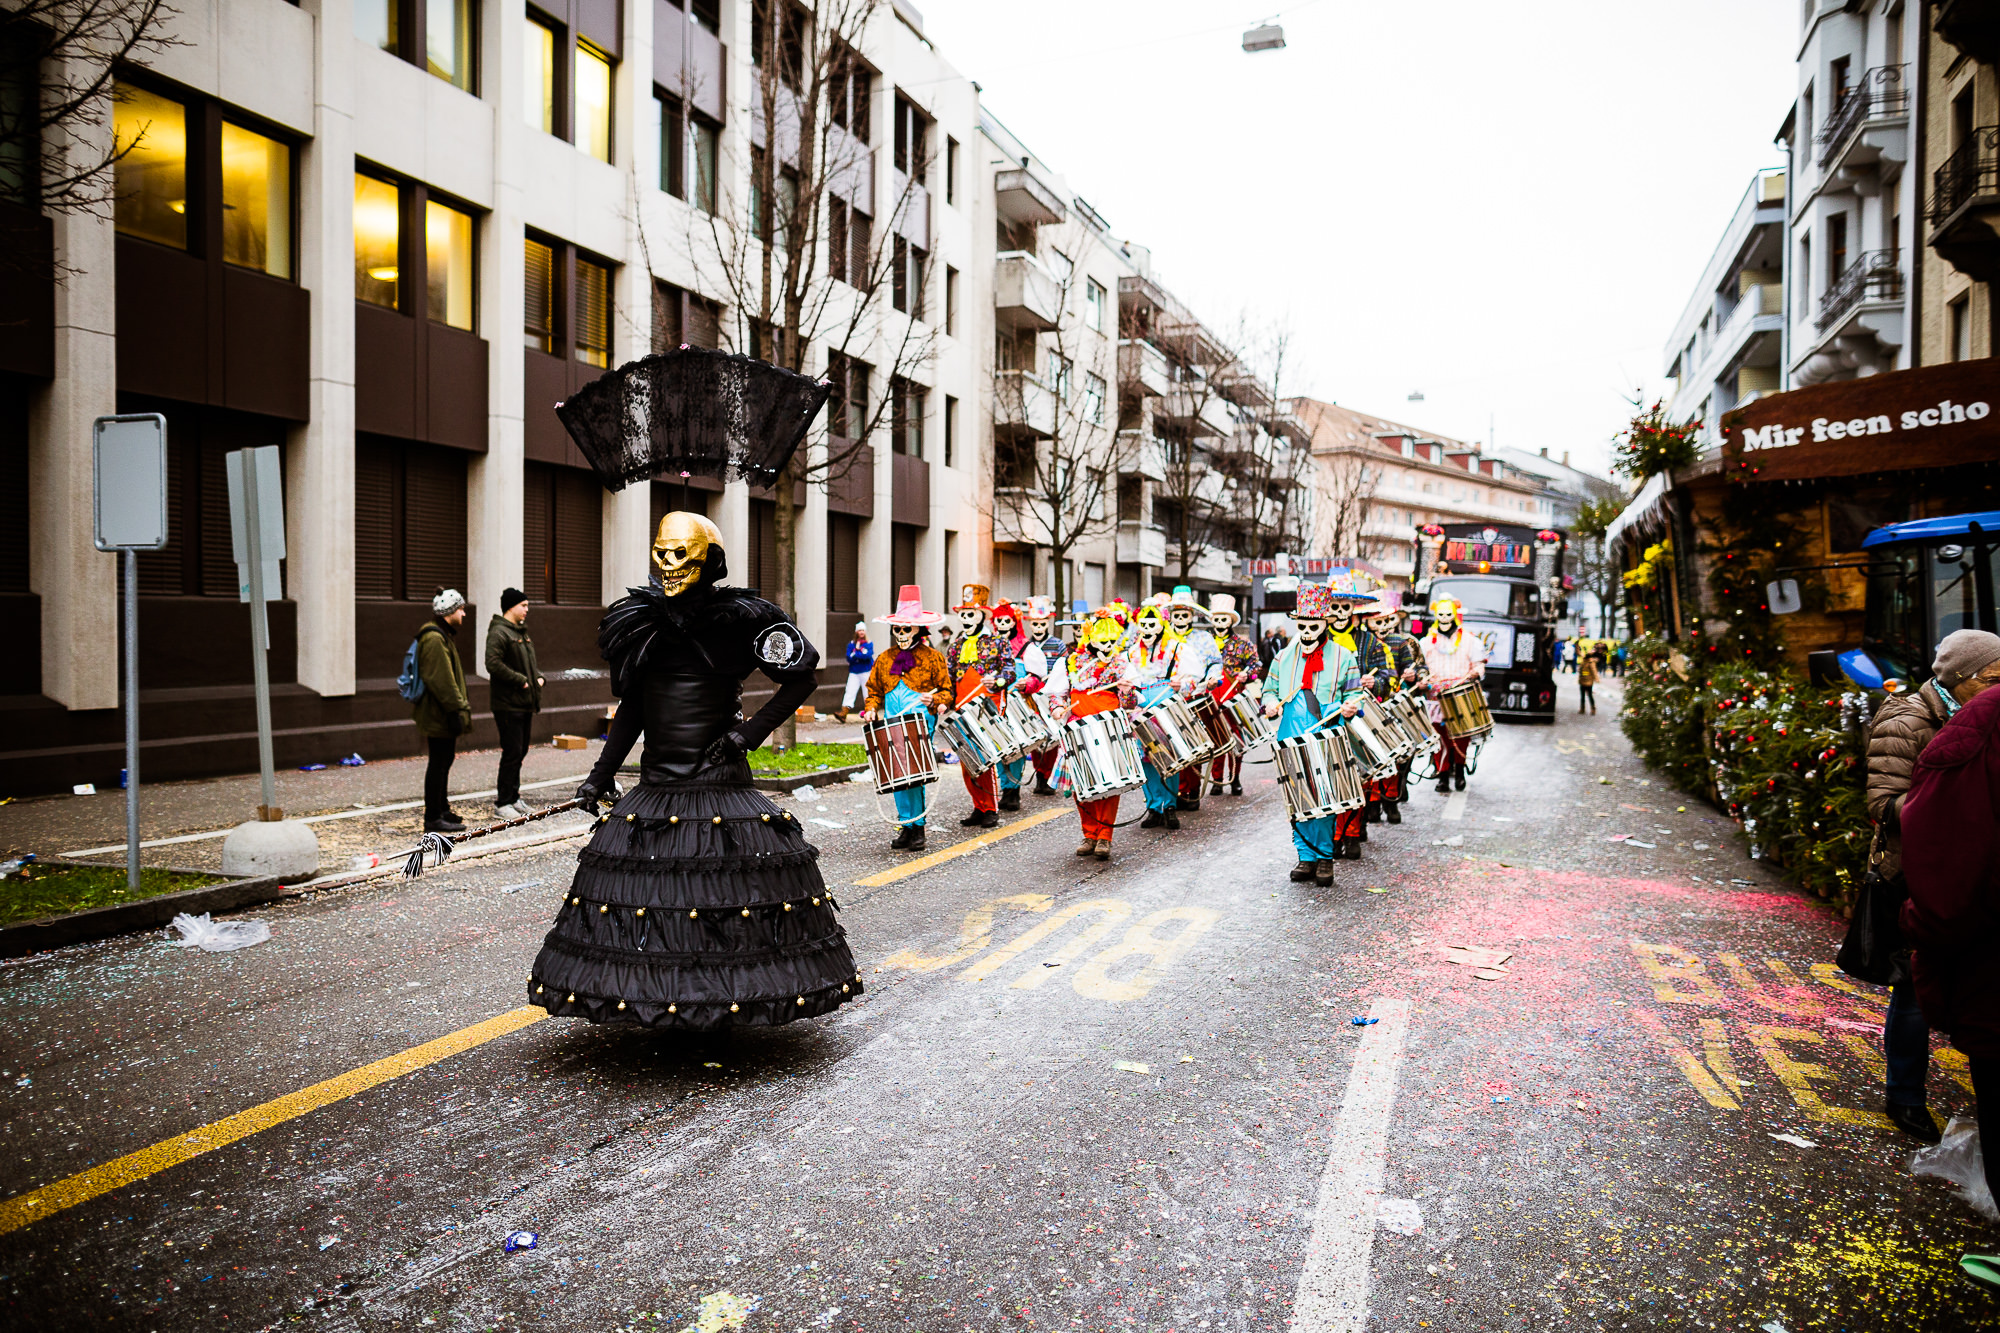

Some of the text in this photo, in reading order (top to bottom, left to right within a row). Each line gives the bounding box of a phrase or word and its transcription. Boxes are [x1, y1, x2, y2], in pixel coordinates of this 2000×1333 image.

[1742, 400, 1990, 452] Mir feen scho
[1500, 693, 1529, 709] 2016
[884, 893, 1223, 1001] BUS
